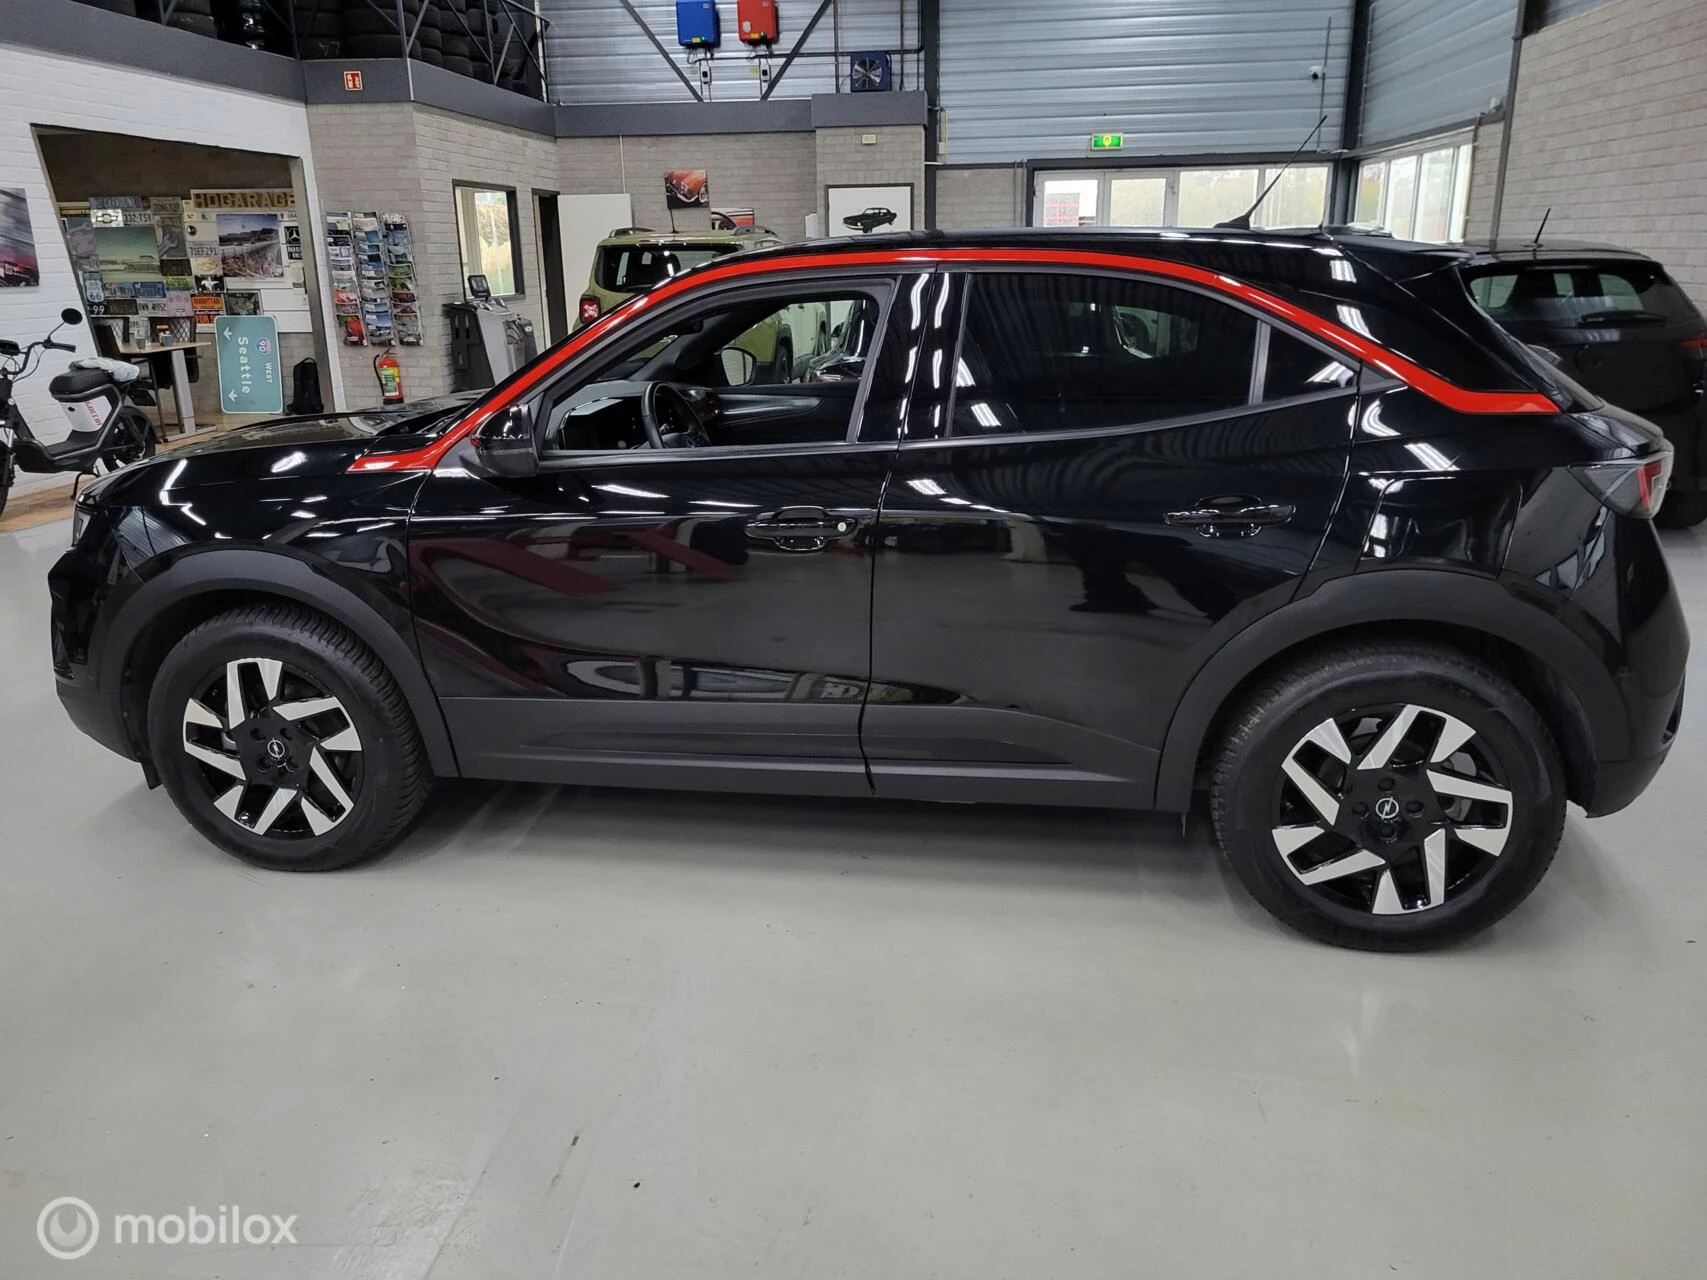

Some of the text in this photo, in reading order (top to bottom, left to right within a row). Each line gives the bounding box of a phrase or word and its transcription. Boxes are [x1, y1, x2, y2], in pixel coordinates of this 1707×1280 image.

[89, 291, 102, 301] 66
[92, 305, 105, 315] 99
[238, 336, 252, 394] Seattle
[258, 340, 273, 383] 90 WEST
